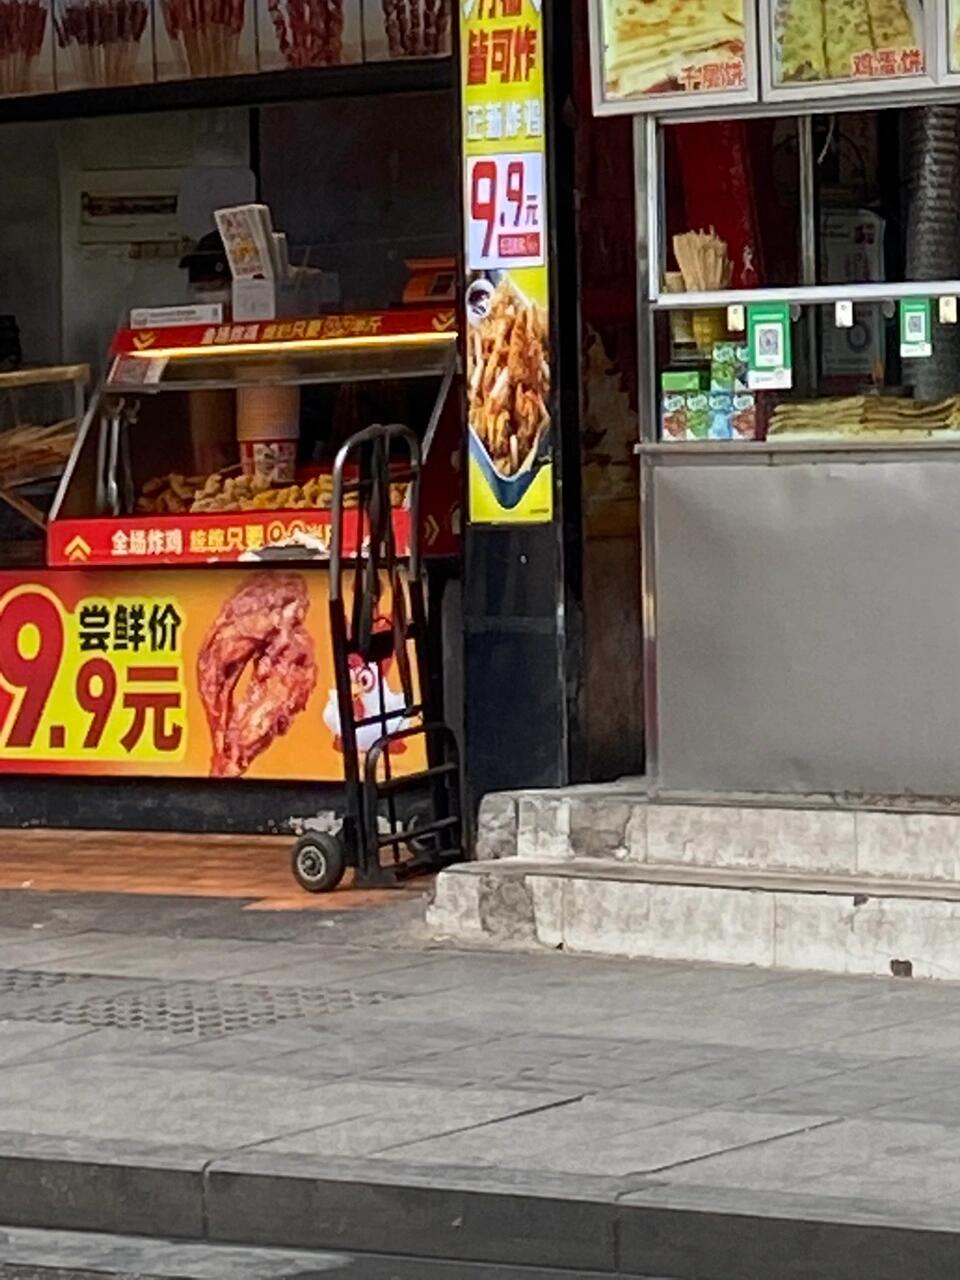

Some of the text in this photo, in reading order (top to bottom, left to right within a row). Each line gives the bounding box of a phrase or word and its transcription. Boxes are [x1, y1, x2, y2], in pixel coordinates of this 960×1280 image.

[852, 48, 926, 77] 鸡蛋饼
[471, 161, 538, 258] 9.9元
[111, 528, 183, 556] 全场炸鸡
[78, 603, 182, 652] 尝鲜价
[0, 592, 183, 753] 9.9元
